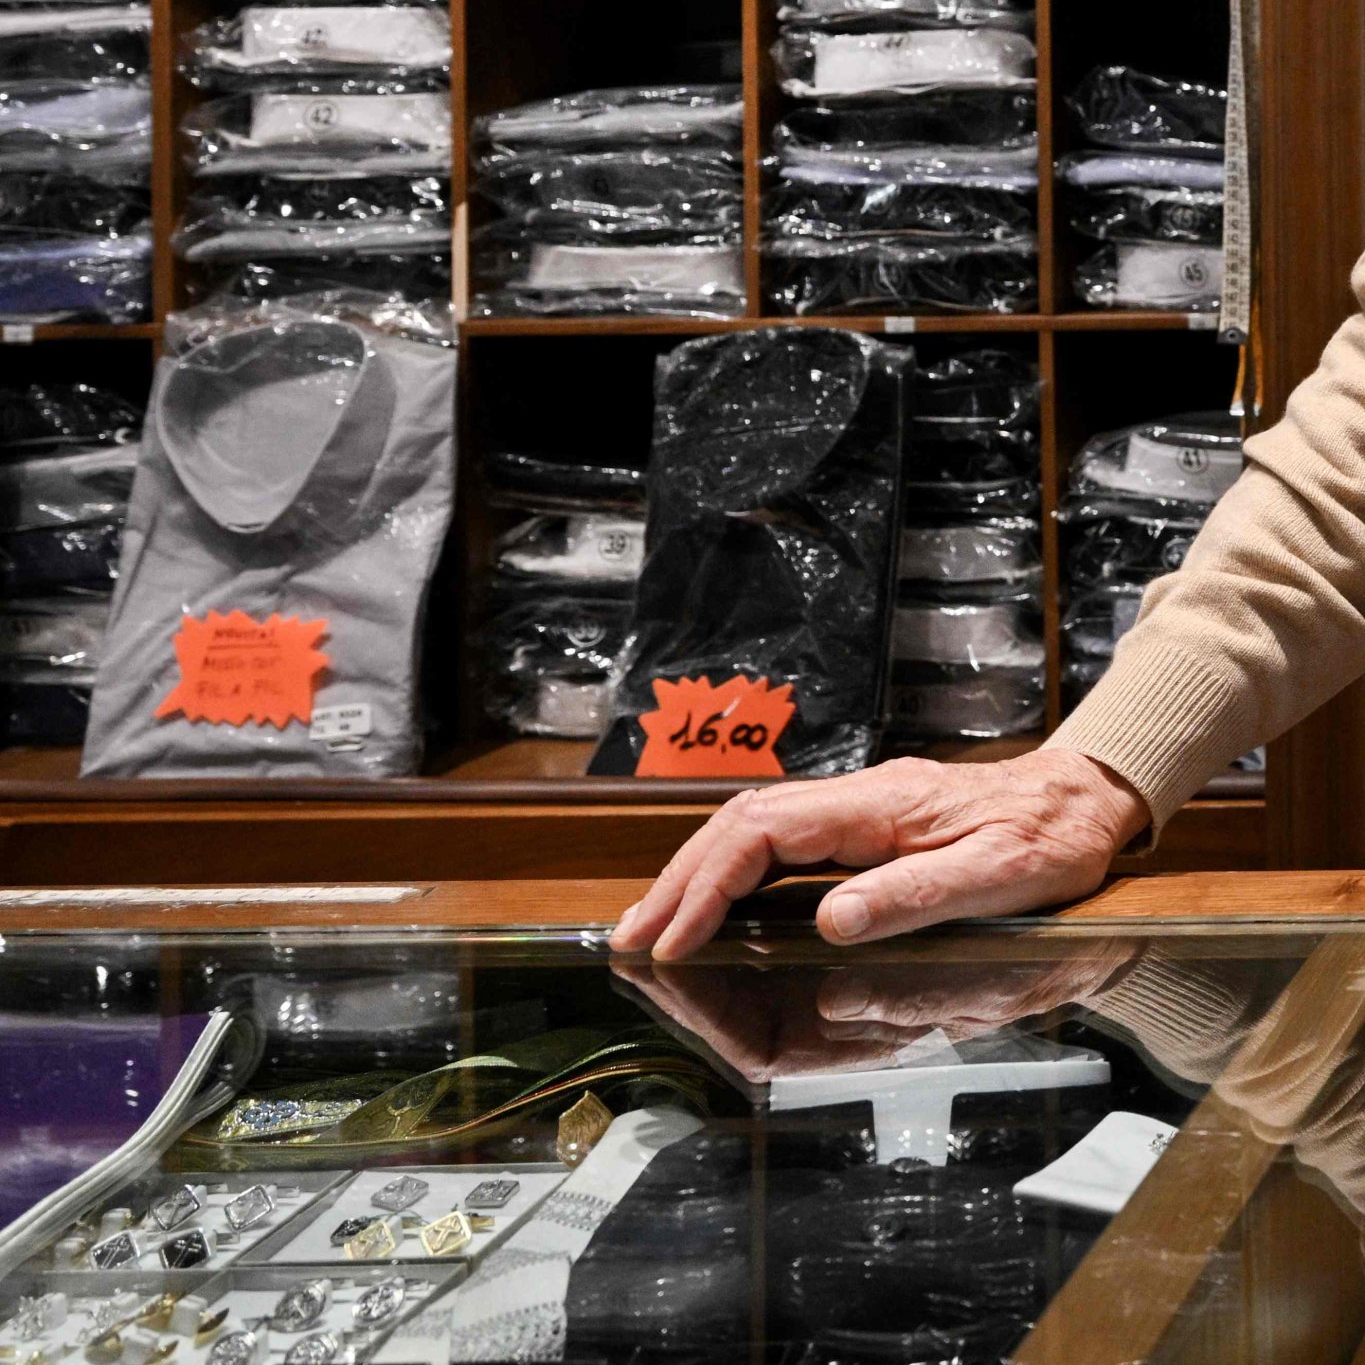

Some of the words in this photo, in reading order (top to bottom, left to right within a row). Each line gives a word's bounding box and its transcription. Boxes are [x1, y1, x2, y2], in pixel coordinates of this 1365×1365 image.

[1183, 262, 1202, 282] 45
[1181, 449, 1201, 467] 41
[604, 533, 626, 554] 39
[669, 711, 768, 754] 16,00
